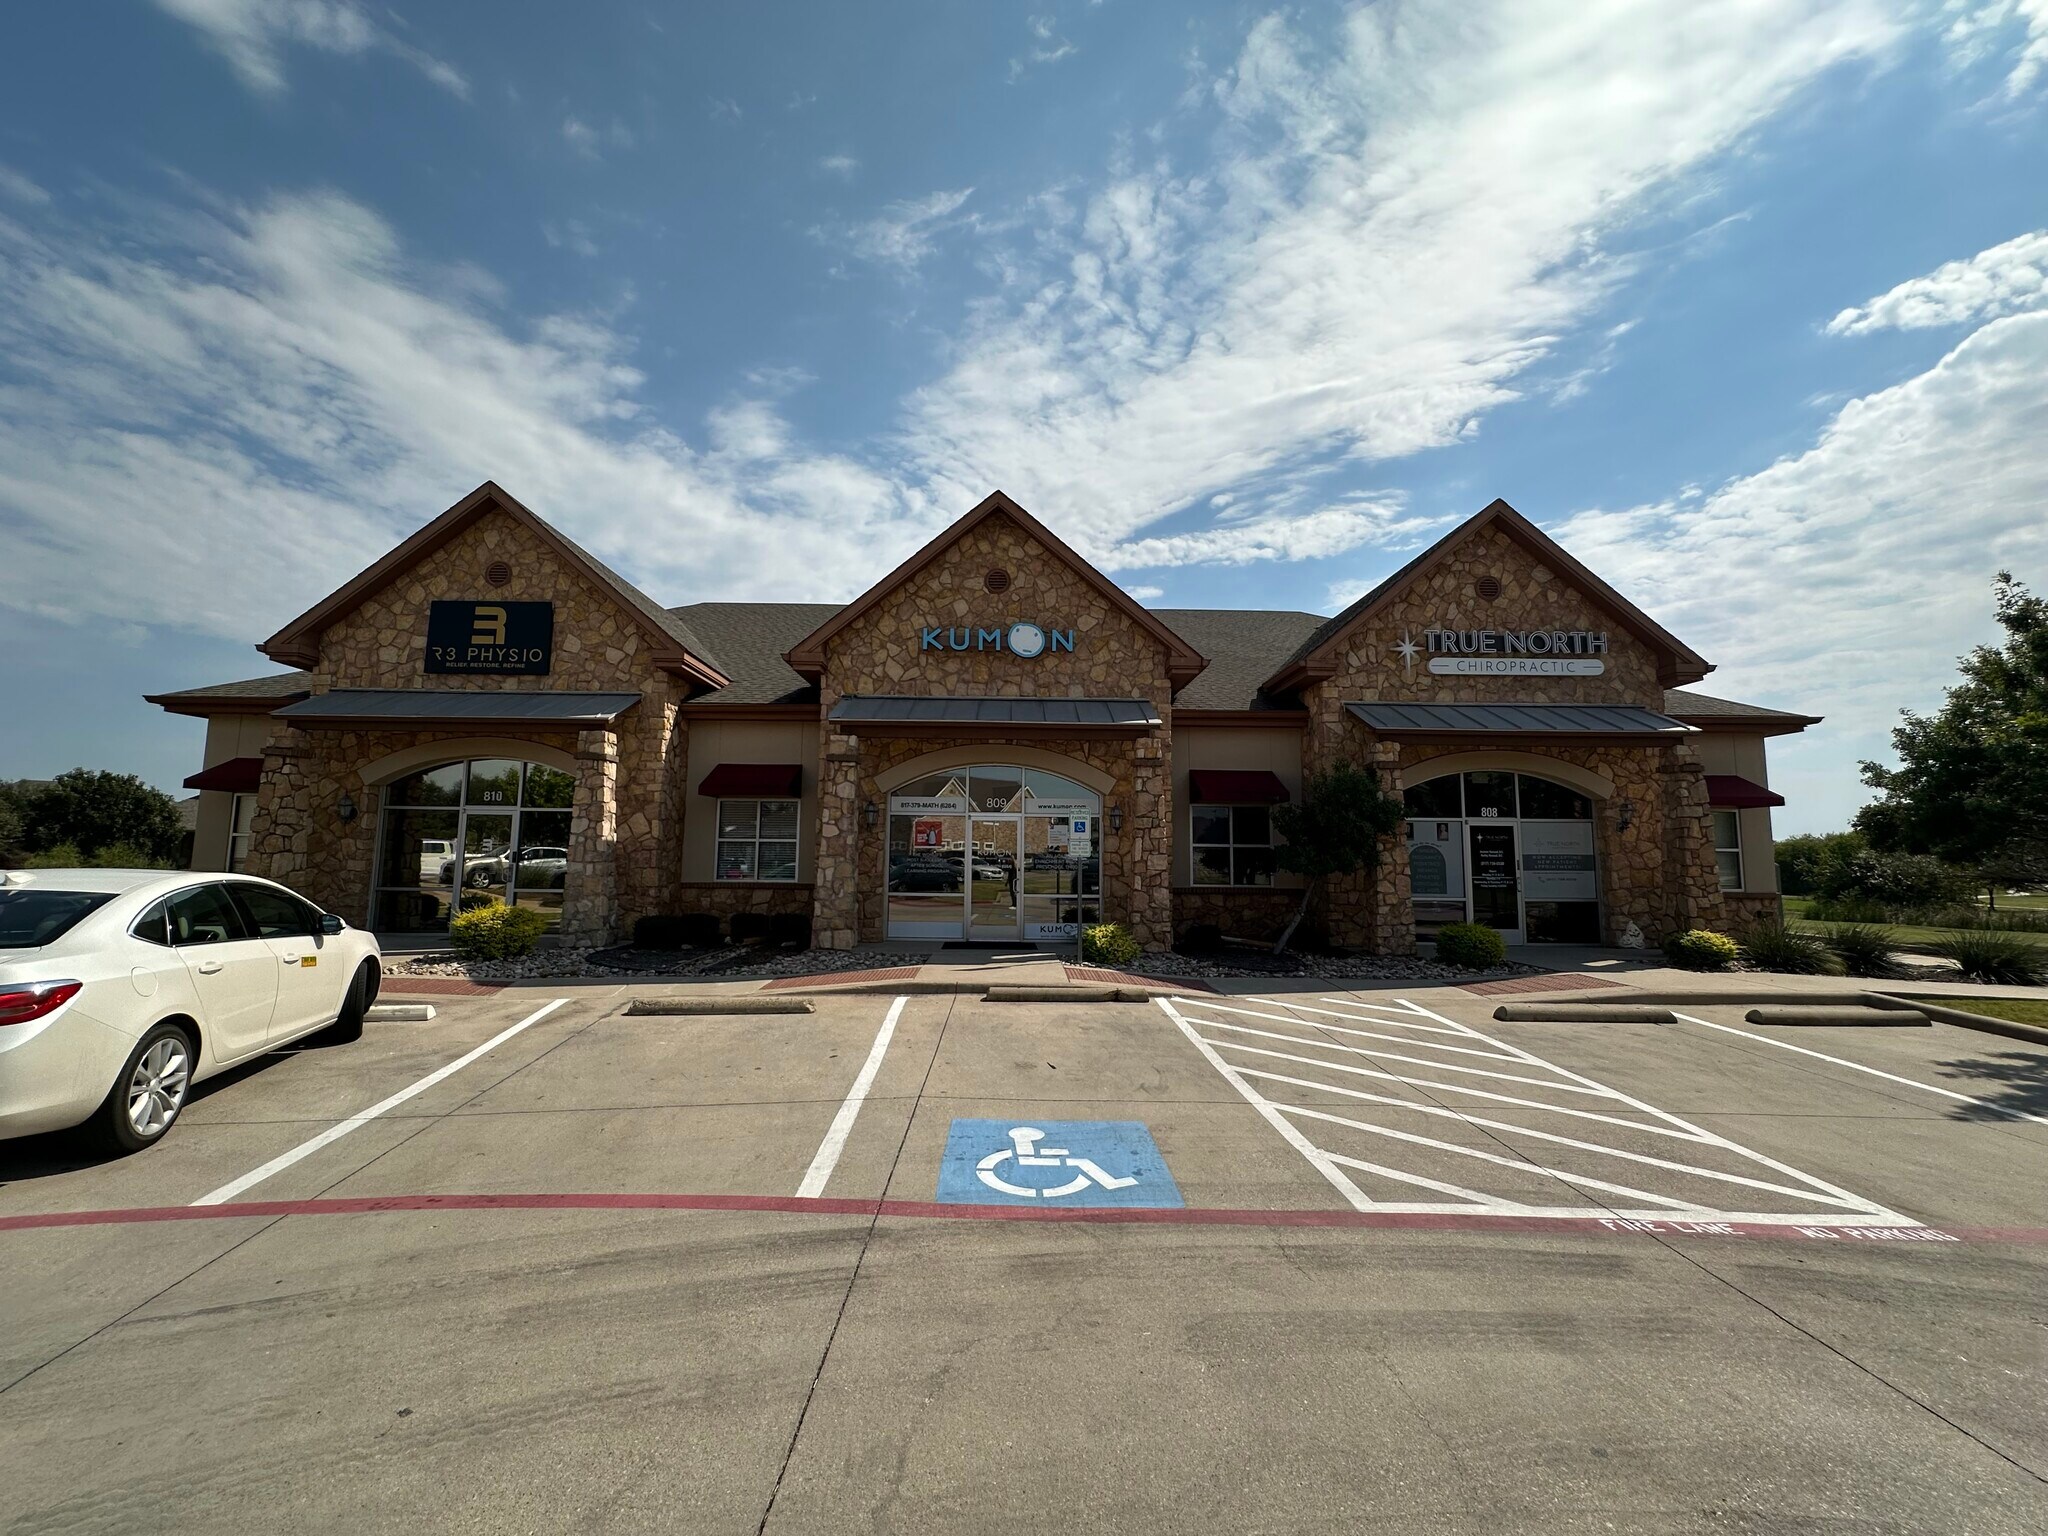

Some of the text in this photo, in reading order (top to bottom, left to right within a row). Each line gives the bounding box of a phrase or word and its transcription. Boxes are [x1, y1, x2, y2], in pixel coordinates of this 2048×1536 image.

[921, 622, 1074, 659] KUMON
[1424, 629, 1608, 654] TRUE NORTH
[431, 646, 543, 662] R3 PHYSIO
[1456, 660, 1576, 673] CHIROPRACTIC
[483, 791, 503, 801] 810
[986, 797, 1007, 808] 809
[1481, 807, 1498, 817] 808
[1040, 924, 1081, 935] KUMO
[1598, 1218, 1746, 1235] FIRE LANE
[1792, 1226, 1961, 1242] NO PARKING
